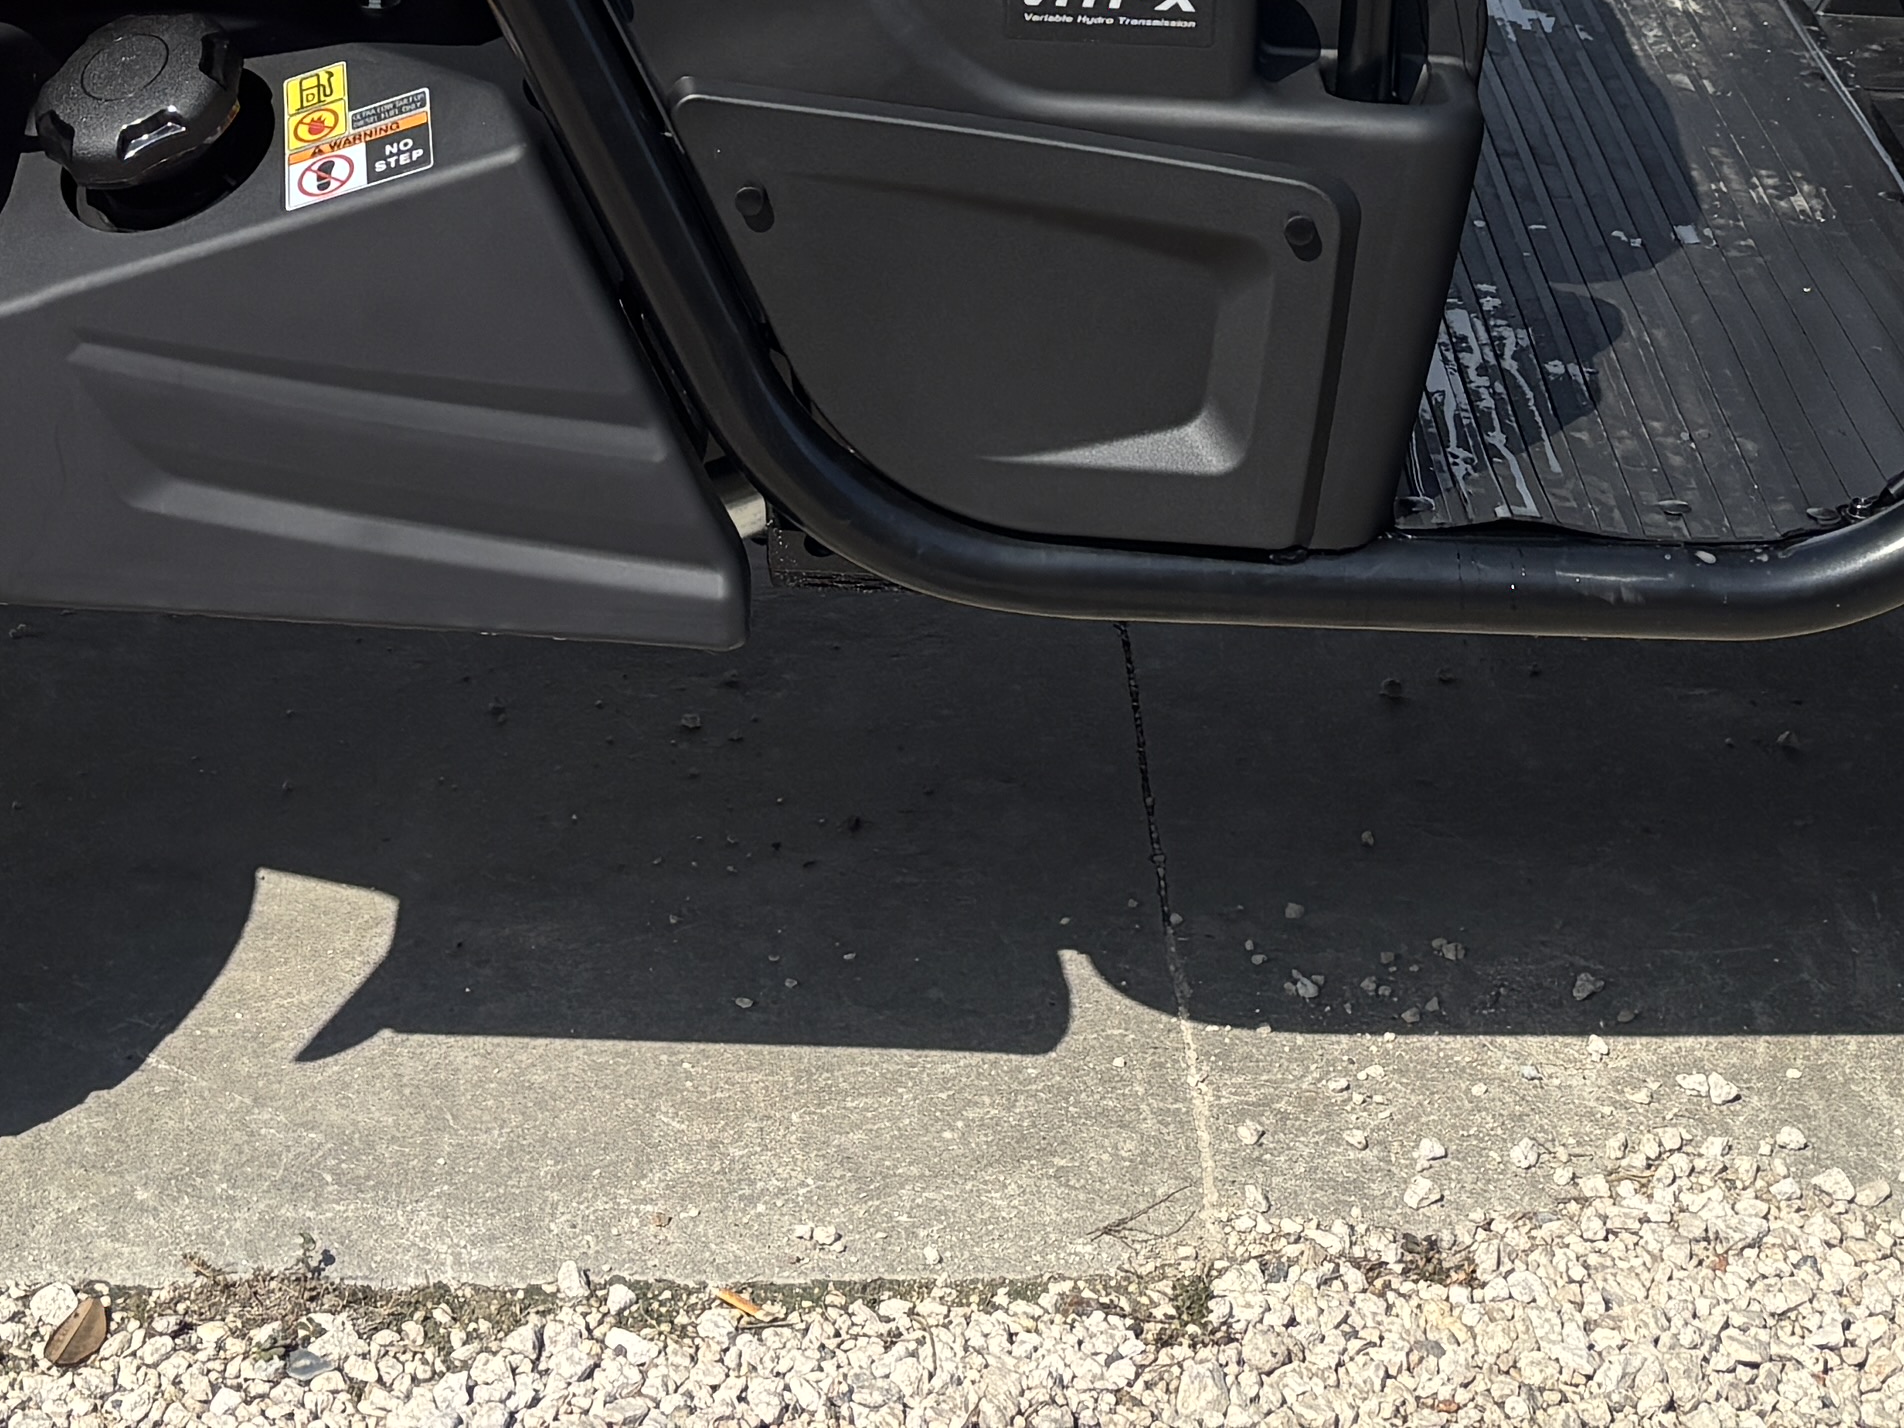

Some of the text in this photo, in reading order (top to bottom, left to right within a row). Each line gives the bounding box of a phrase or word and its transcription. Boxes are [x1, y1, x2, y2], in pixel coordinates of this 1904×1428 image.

[1024, 12, 1197, 28] Variable Hydro Transmission
[329, 122, 401, 150] WARNING
[384, 138, 413, 157] NO
[374, 148, 424, 173] STEP
